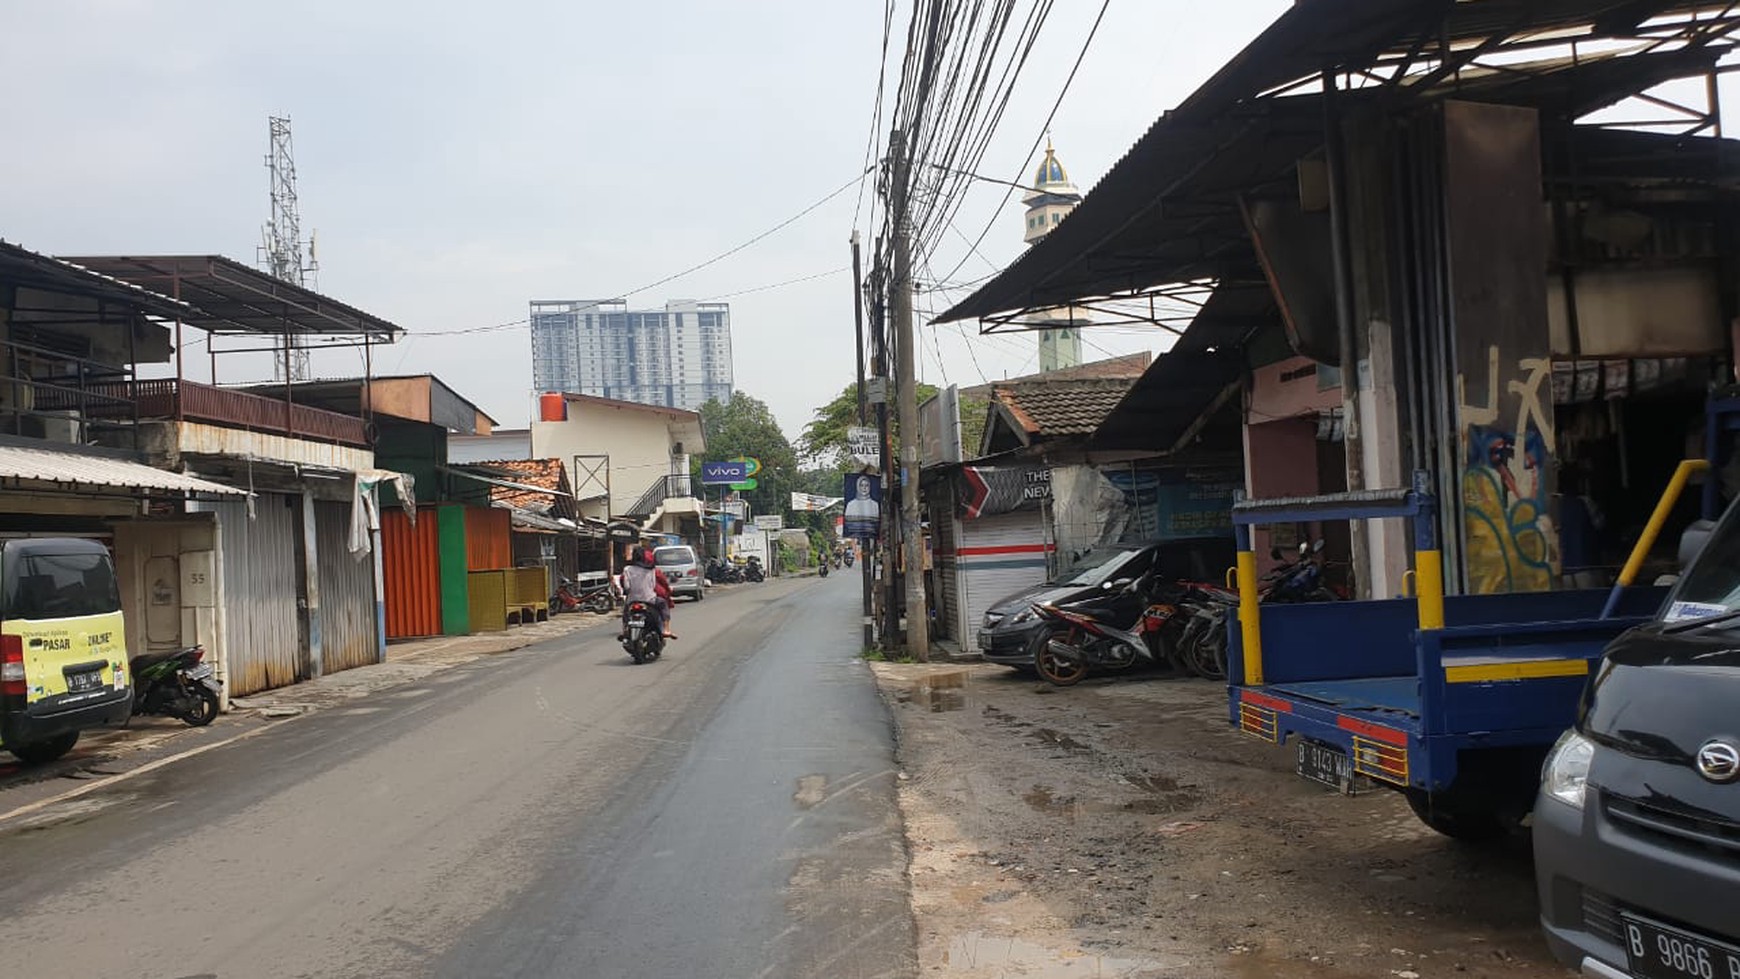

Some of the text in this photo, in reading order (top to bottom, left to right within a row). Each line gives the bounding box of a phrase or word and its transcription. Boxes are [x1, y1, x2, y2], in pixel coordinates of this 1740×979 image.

[708, 466, 740, 476] vivo
[1025, 470, 1050, 482] THE
[42, 638, 70, 651] PASAR
[1299, 743, 1305, 763] B
[1627, 924, 1645, 958] B
[1658, 934, 1712, 979] 9866
